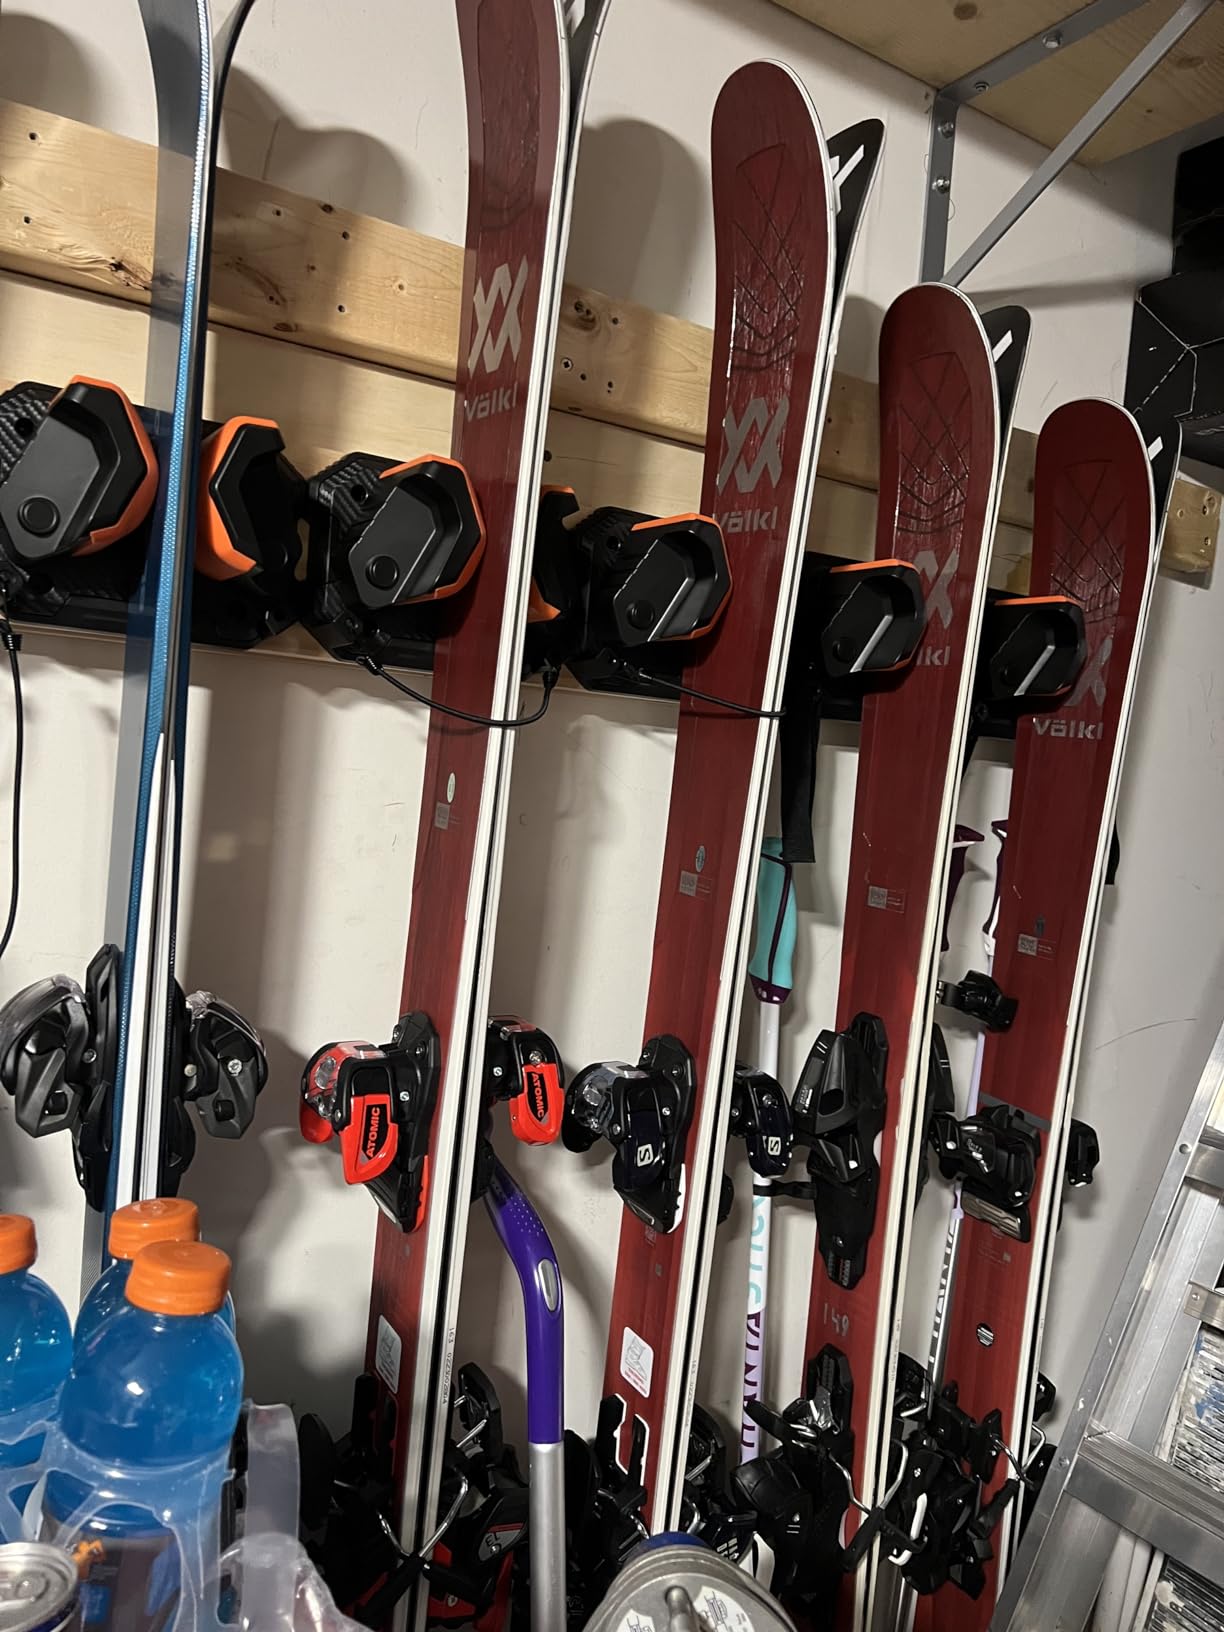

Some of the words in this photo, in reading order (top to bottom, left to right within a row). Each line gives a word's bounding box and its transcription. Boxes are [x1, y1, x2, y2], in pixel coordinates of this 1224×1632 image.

[916, 645, 951, 667] lkl
[530, 1072, 545, 1120] ATOMIC
[364, 1106, 382, 1159] ATOMIC
